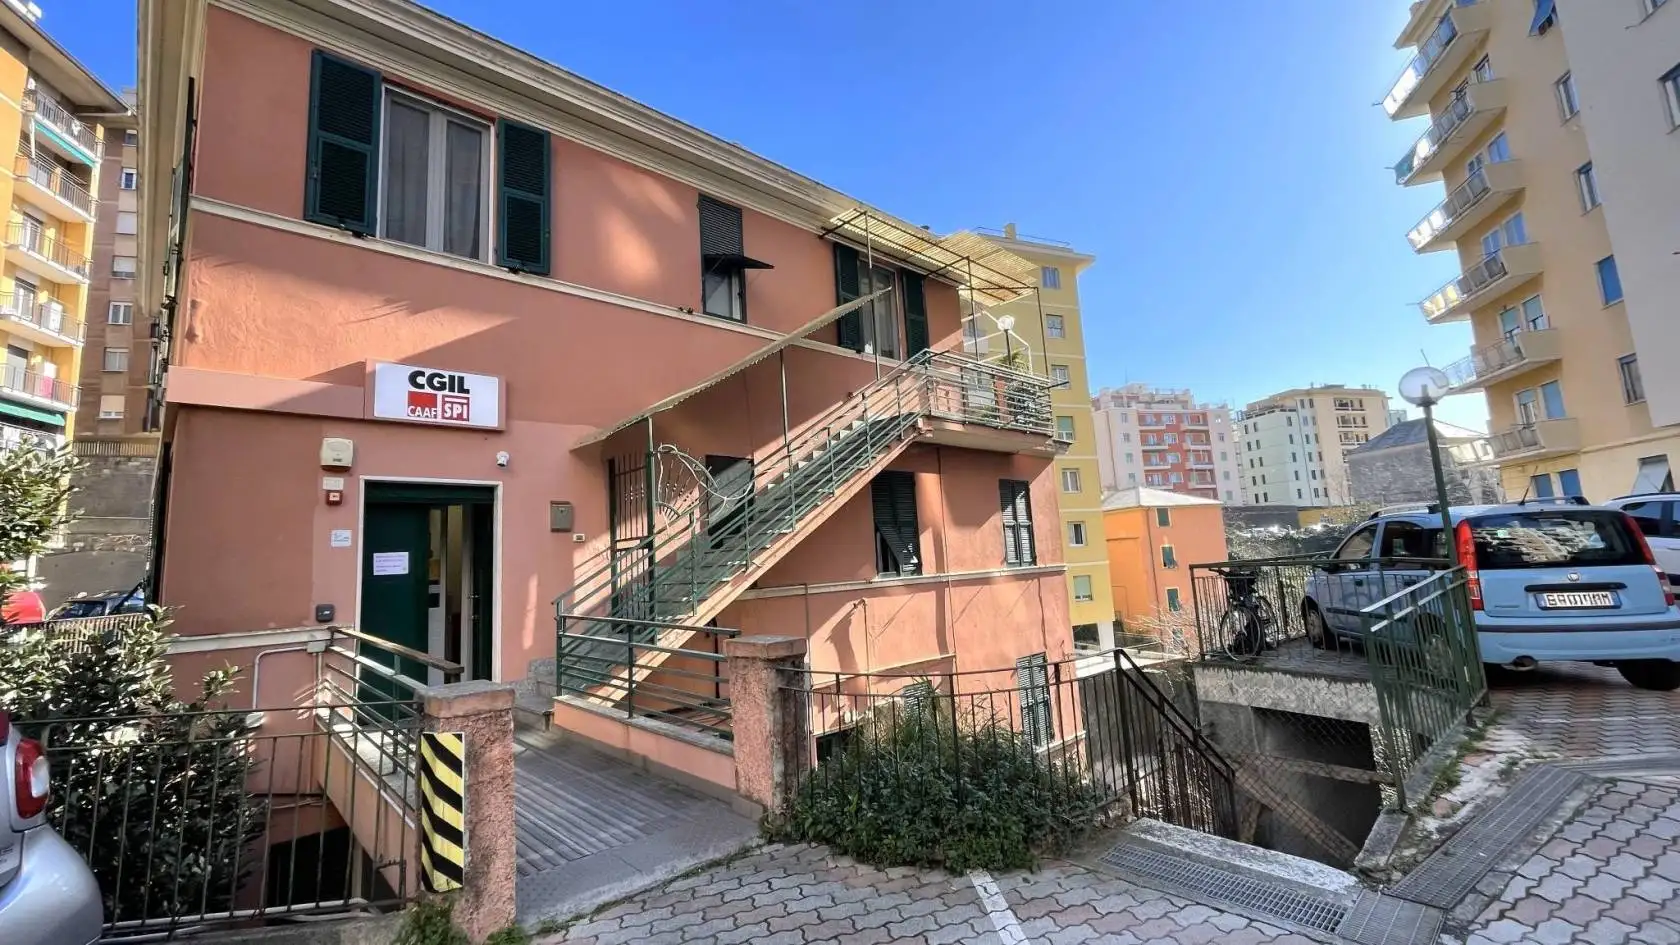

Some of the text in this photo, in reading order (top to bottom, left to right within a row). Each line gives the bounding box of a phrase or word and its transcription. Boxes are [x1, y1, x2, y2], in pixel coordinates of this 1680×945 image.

[408, 370, 470, 394] CGIL
[408, 405, 437, 418] CAAF
[444, 403, 468, 419] SPI
